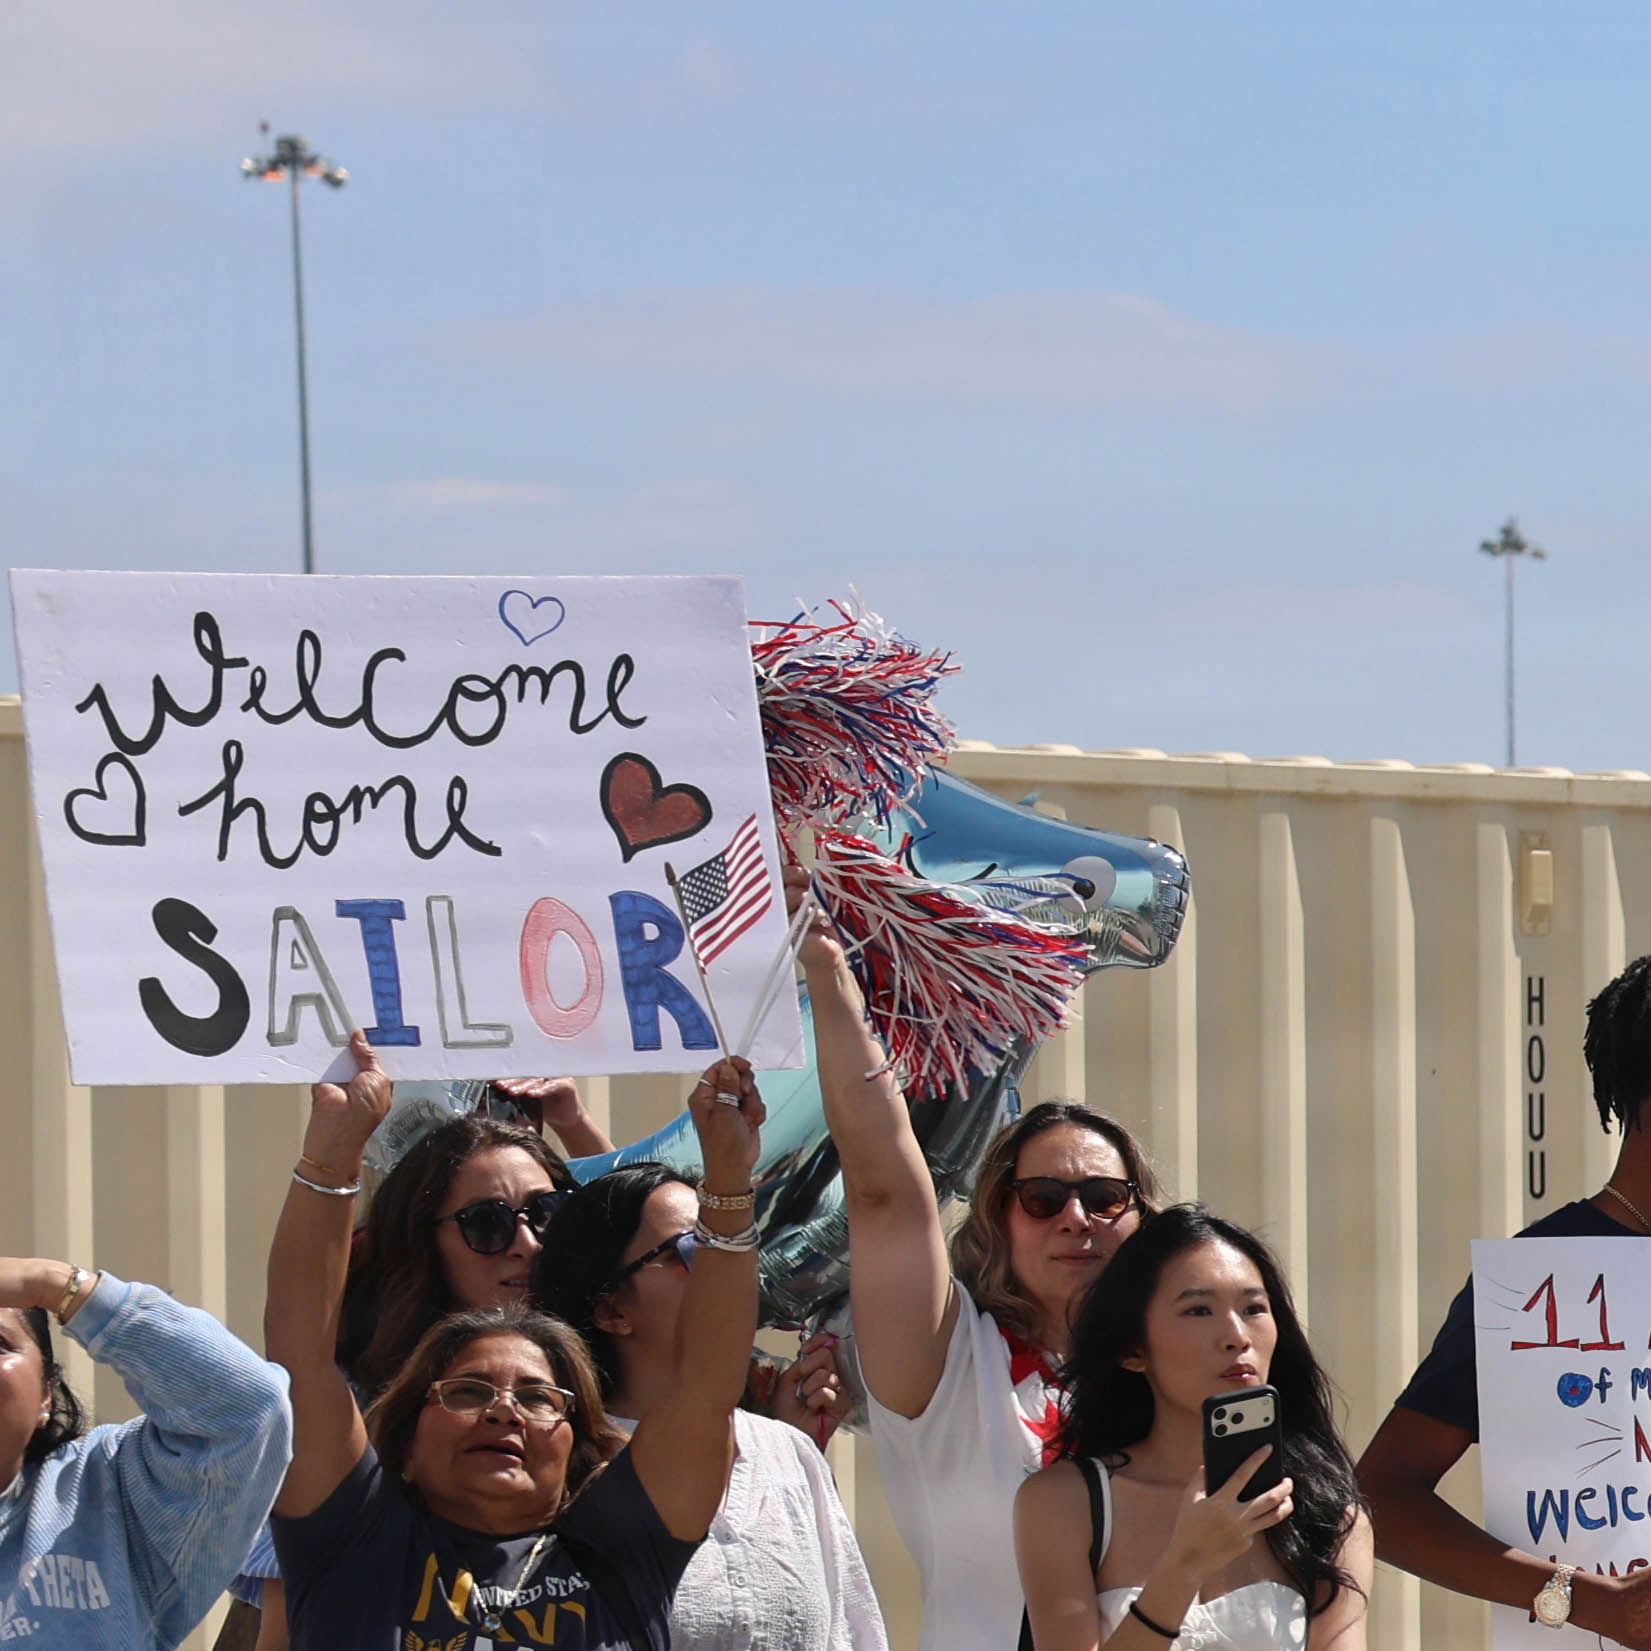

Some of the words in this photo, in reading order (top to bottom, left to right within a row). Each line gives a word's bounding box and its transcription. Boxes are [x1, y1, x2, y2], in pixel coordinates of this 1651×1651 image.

[76, 611, 648, 756] Welcome
[177, 740, 502, 869] home
[138, 890, 719, 1057] SAILOR
[1511, 1272, 1625, 1351] 11
